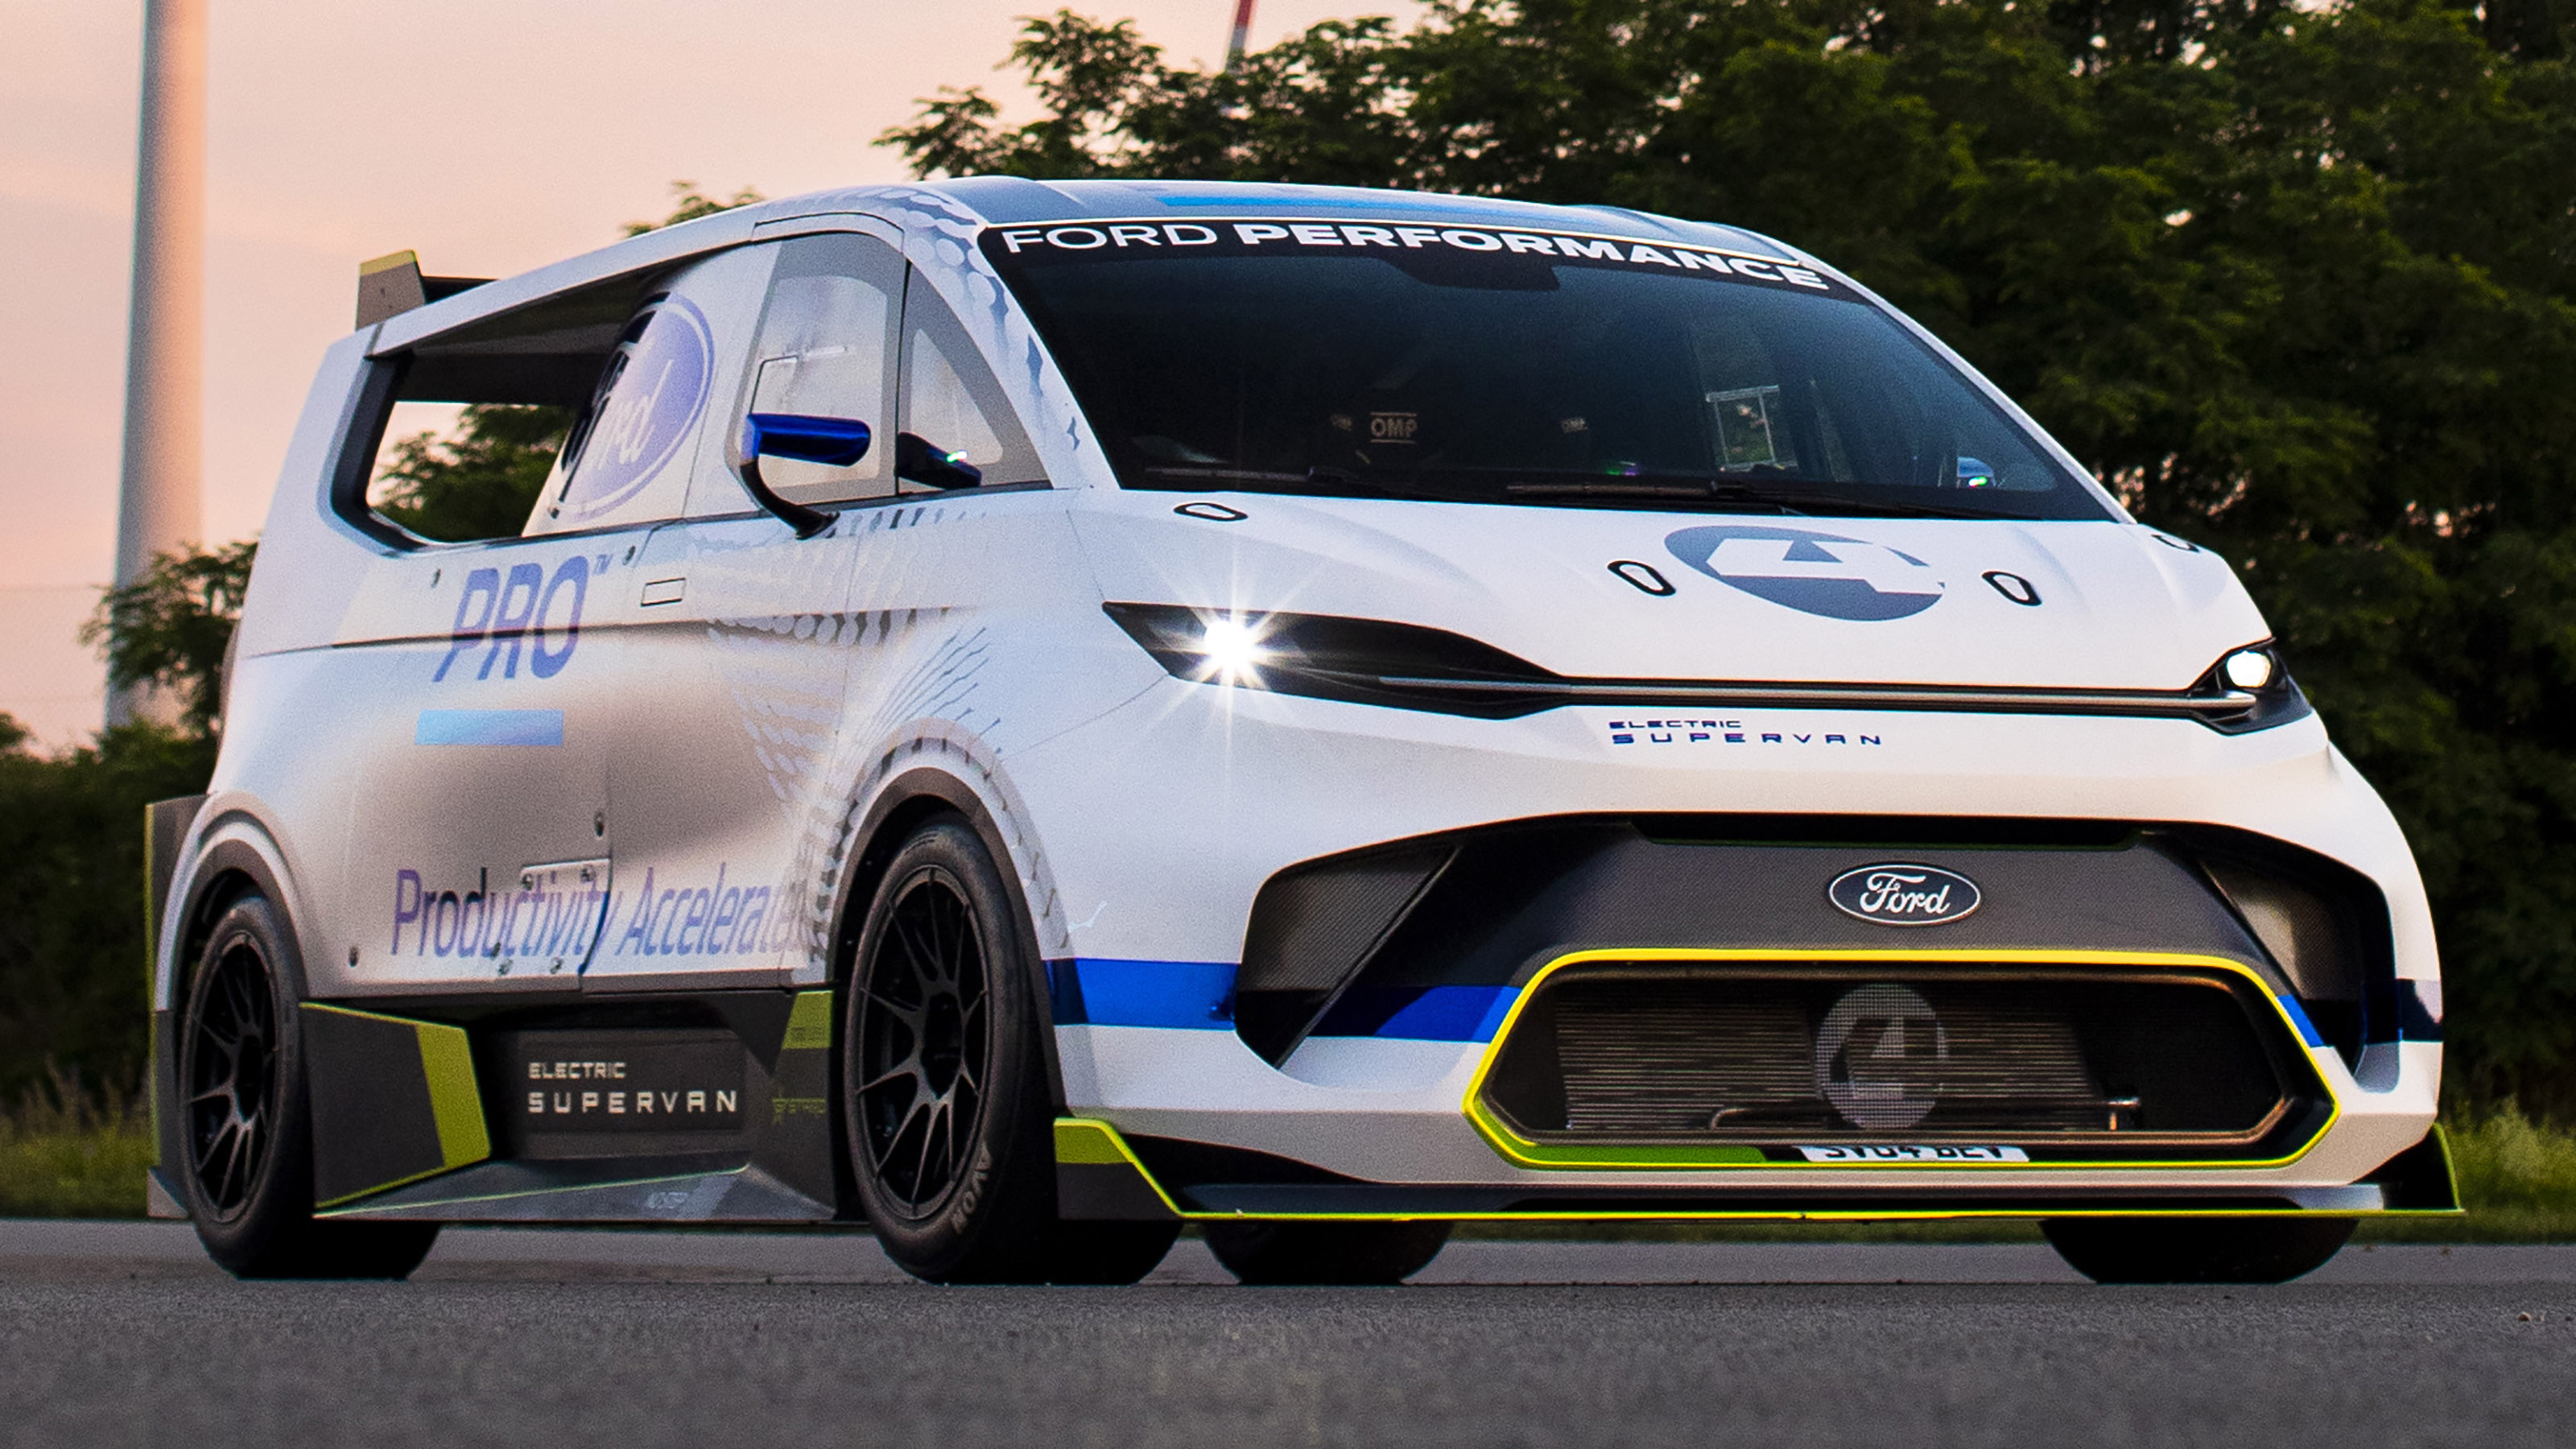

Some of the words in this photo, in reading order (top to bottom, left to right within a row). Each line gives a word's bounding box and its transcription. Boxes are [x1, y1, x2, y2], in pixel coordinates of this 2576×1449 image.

[1001, 224, 1218, 254] FORD
[1232, 224, 1830, 290] PERFORMANCE
[1370, 416, 1418, 439] OMP
[431, 555, 589, 683] PRO
[1608, 720, 1741, 729] ELECTRIC
[1612, 733, 1881, 745] SUPERVAN
[1860, 872, 1951, 914] Ford
[390, 866, 621, 969] Productivity
[528, 1062, 625, 1080] ELECTRIC
[527, 1090, 737, 1114] SUPERVAN
